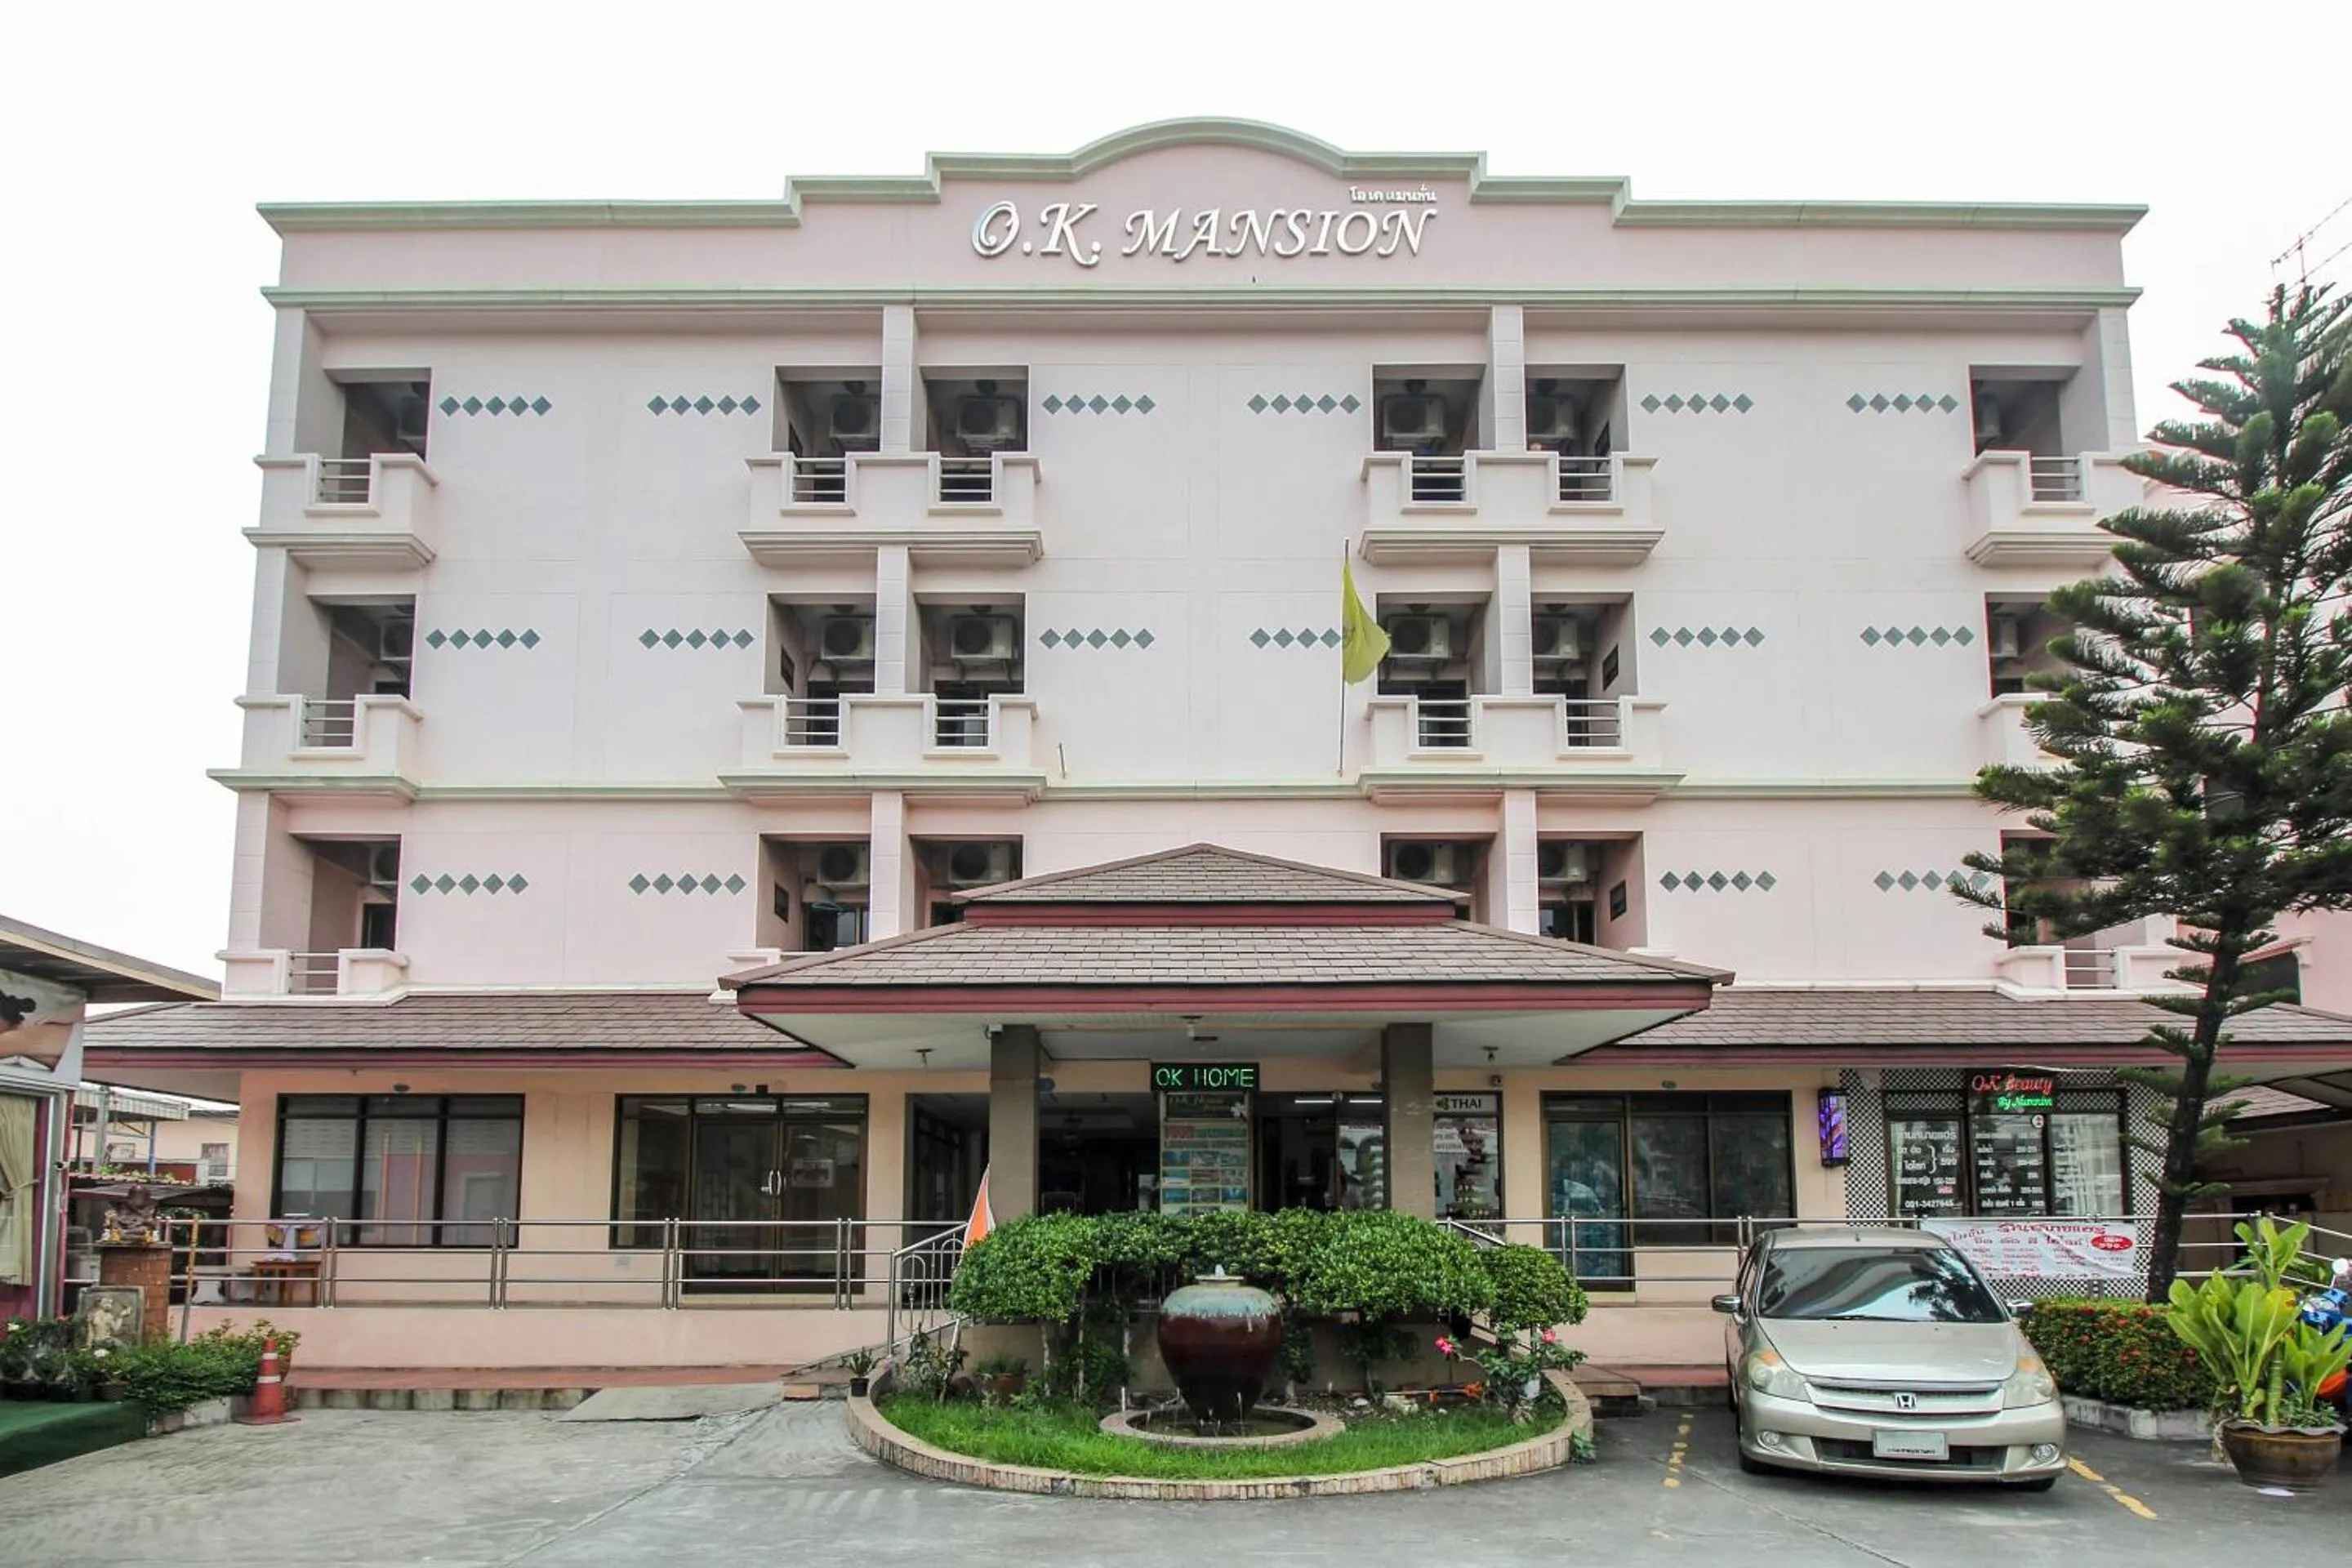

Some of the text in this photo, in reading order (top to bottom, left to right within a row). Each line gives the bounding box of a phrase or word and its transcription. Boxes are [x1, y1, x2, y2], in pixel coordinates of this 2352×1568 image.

[971, 200, 1437, 267] O.K. MANSION
[1156, 1067, 1183, 1086] OK
[1451, 1098, 1481, 1109] THAI
